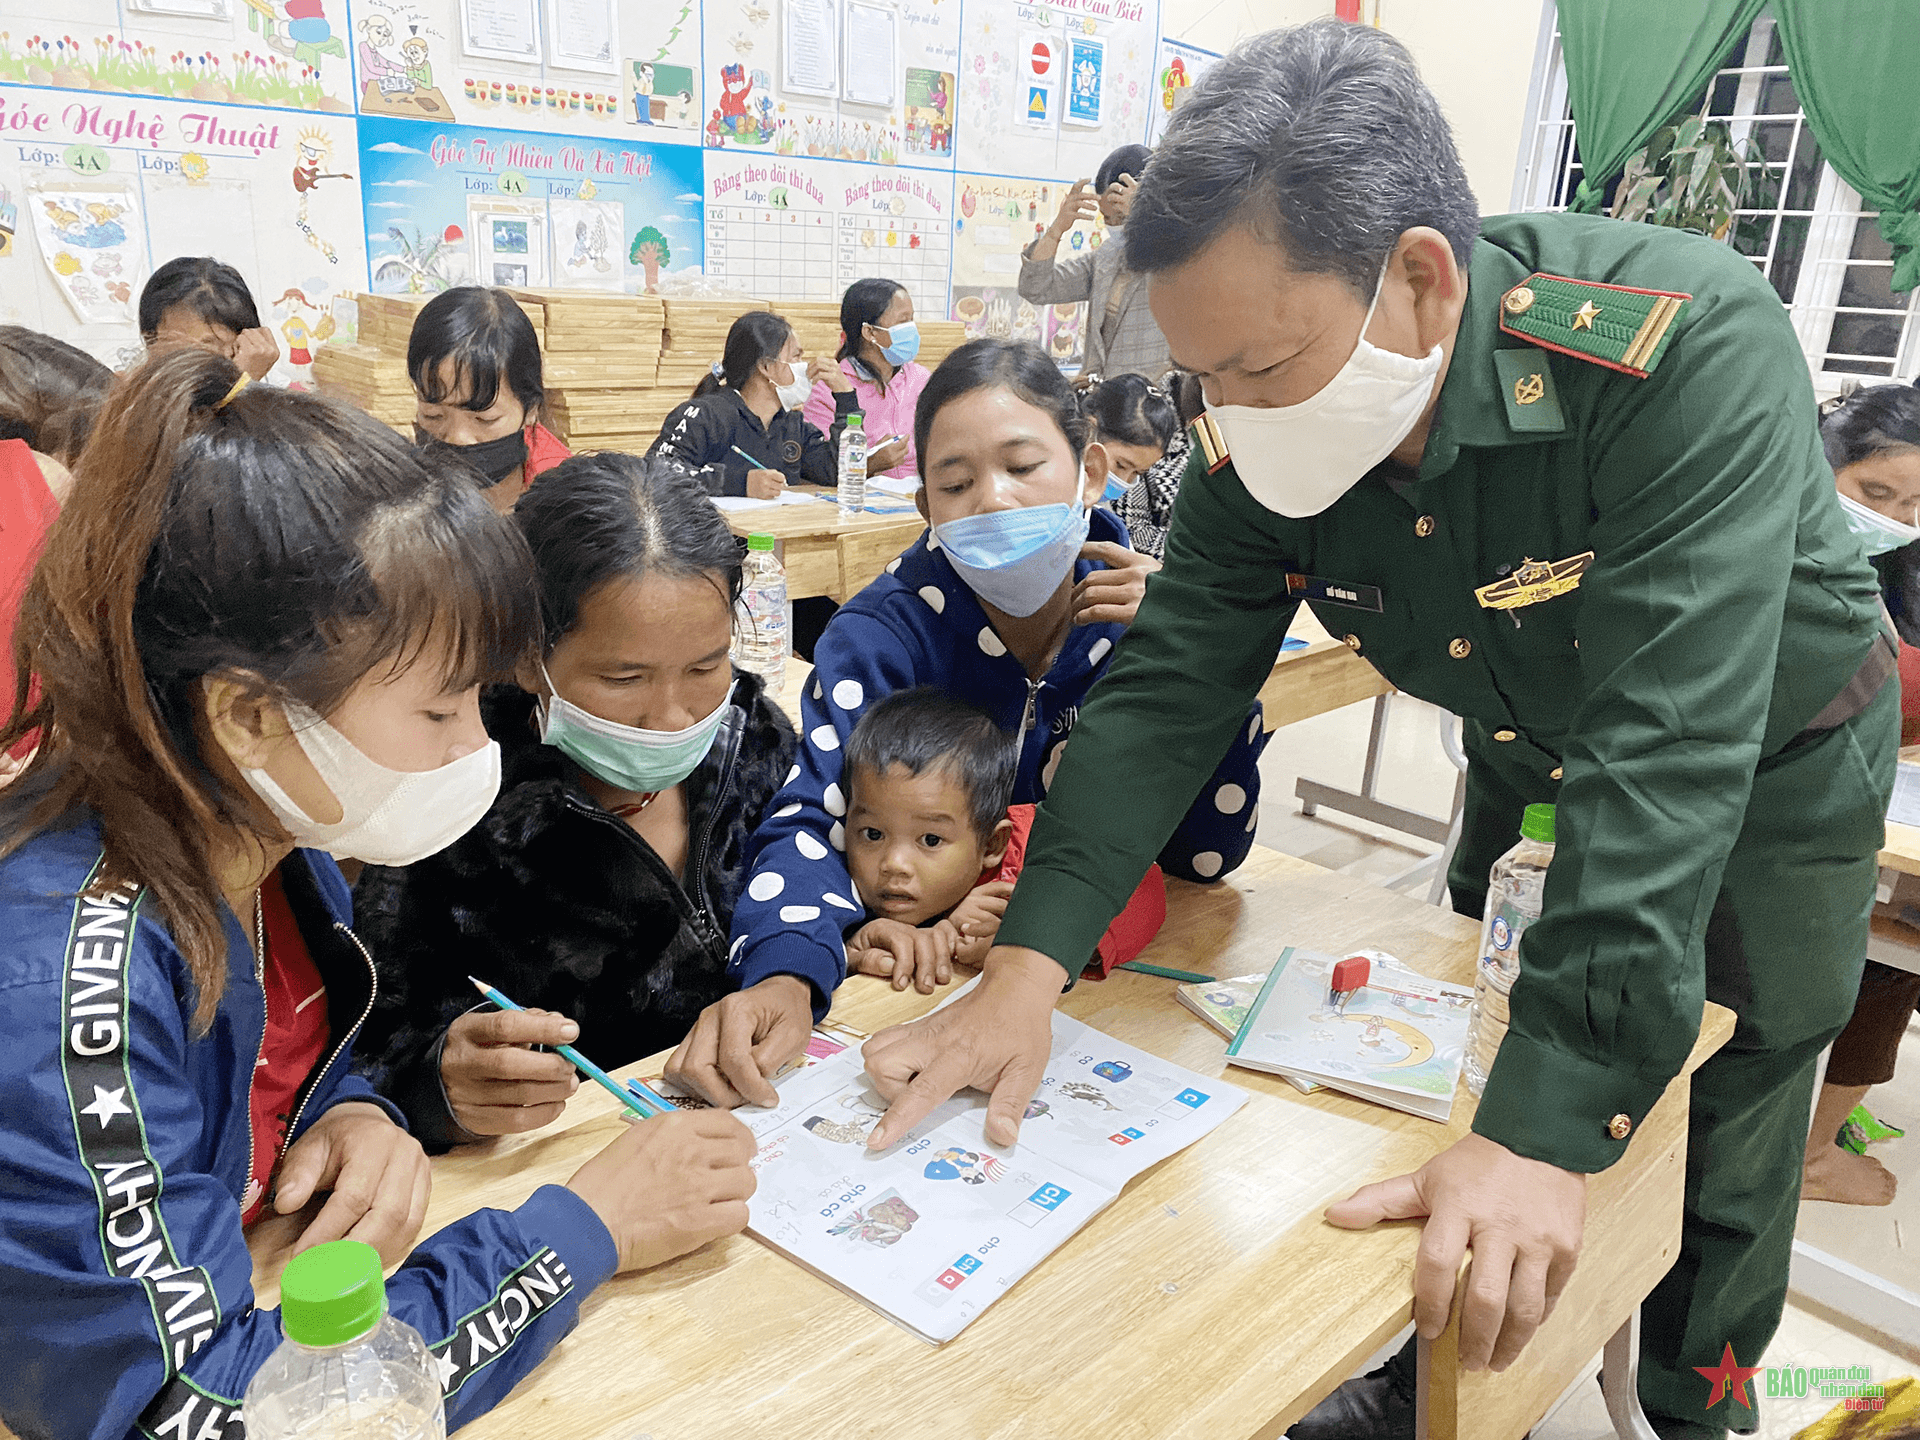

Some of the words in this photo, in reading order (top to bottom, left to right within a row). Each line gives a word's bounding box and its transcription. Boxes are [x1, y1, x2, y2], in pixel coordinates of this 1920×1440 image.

[62, 103, 168, 148] Nghệ
[179, 112, 282, 156] Thuật
[18, 147, 60, 164] Lớp:
[73, 155, 102, 171] 4A
[141, 155, 179, 174] Lớp:
[465, 177, 493, 192] Lớp:
[503, 179, 523, 194] 4A
[744, 163, 768, 184] theo
[789, 169, 804, 190] thi
[549, 183, 575, 198] Lớp:
[872, 174, 893, 193] theo
[913, 180, 925, 200] thi
[906, 1138, 932, 1156] cha
[838, 1183, 867, 1204] chả
[1034, 1186, 1061, 1208] ch
[819, 1201, 841, 1219] cá
[977, 1236, 1001, 1255] cha
[958, 1256, 977, 1272] ch
